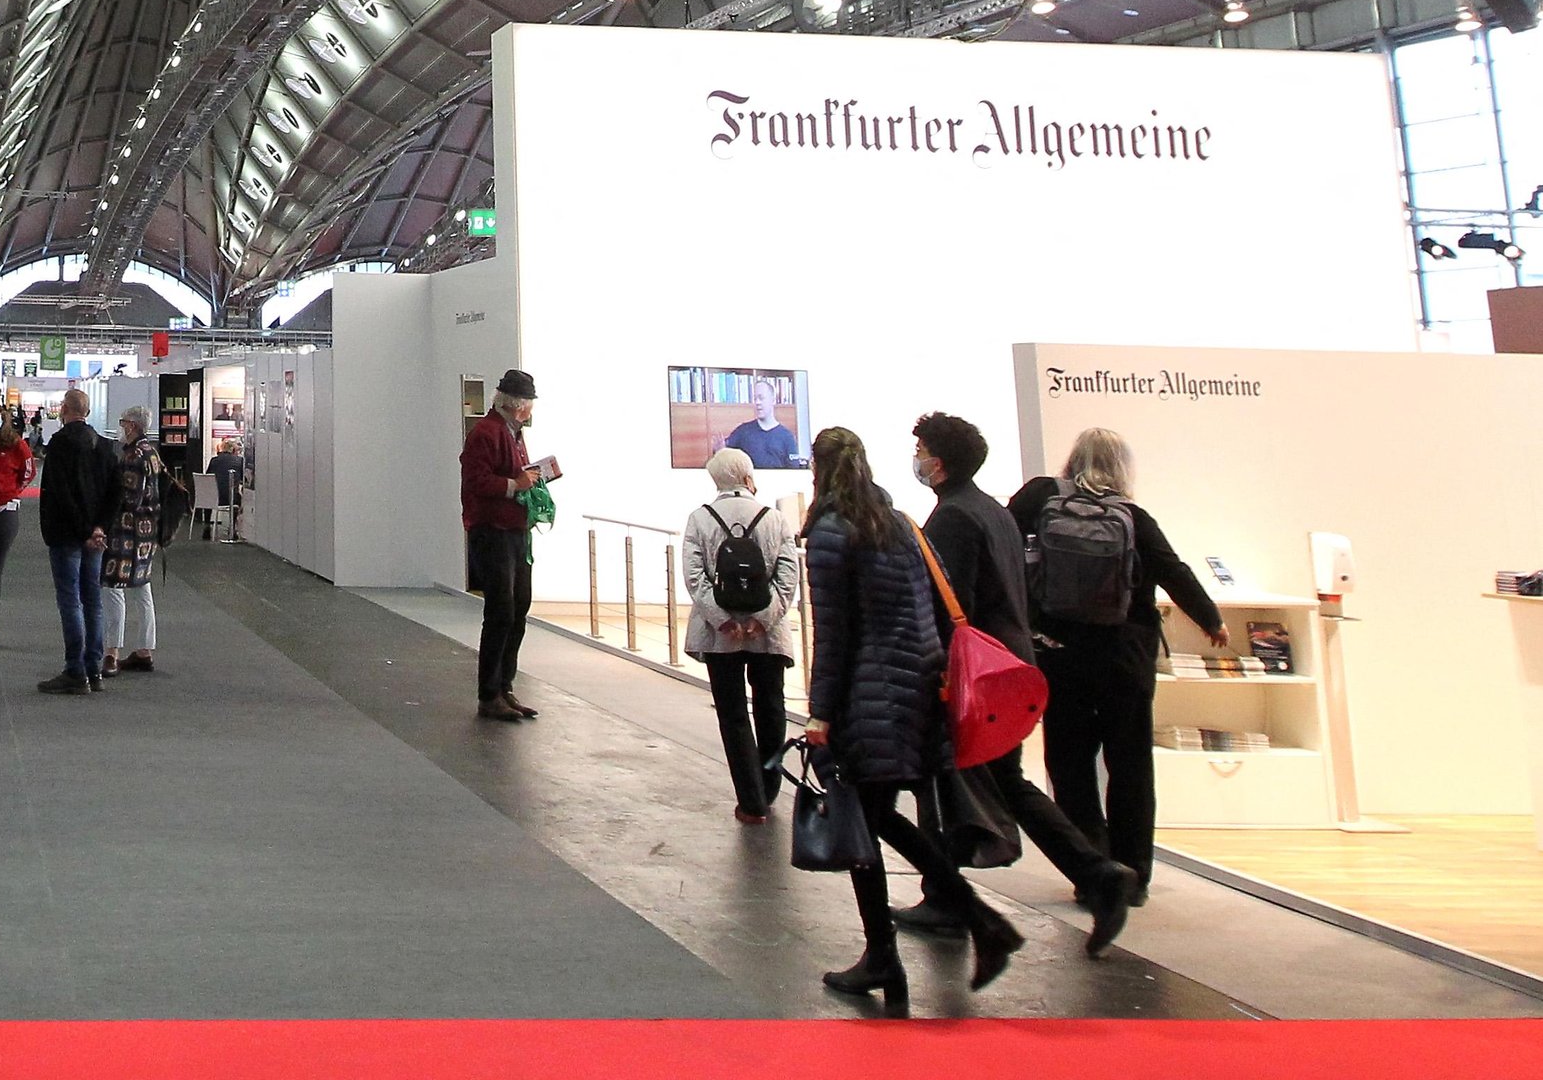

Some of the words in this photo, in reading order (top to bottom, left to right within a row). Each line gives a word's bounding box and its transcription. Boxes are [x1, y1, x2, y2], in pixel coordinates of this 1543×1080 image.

[706, 89, 964, 160] Frankfurter
[972, 99, 1212, 171] Allgemeine
[1046, 367, 1156, 399] Frankfurter
[1158, 369, 1262, 402] Allgemeine
